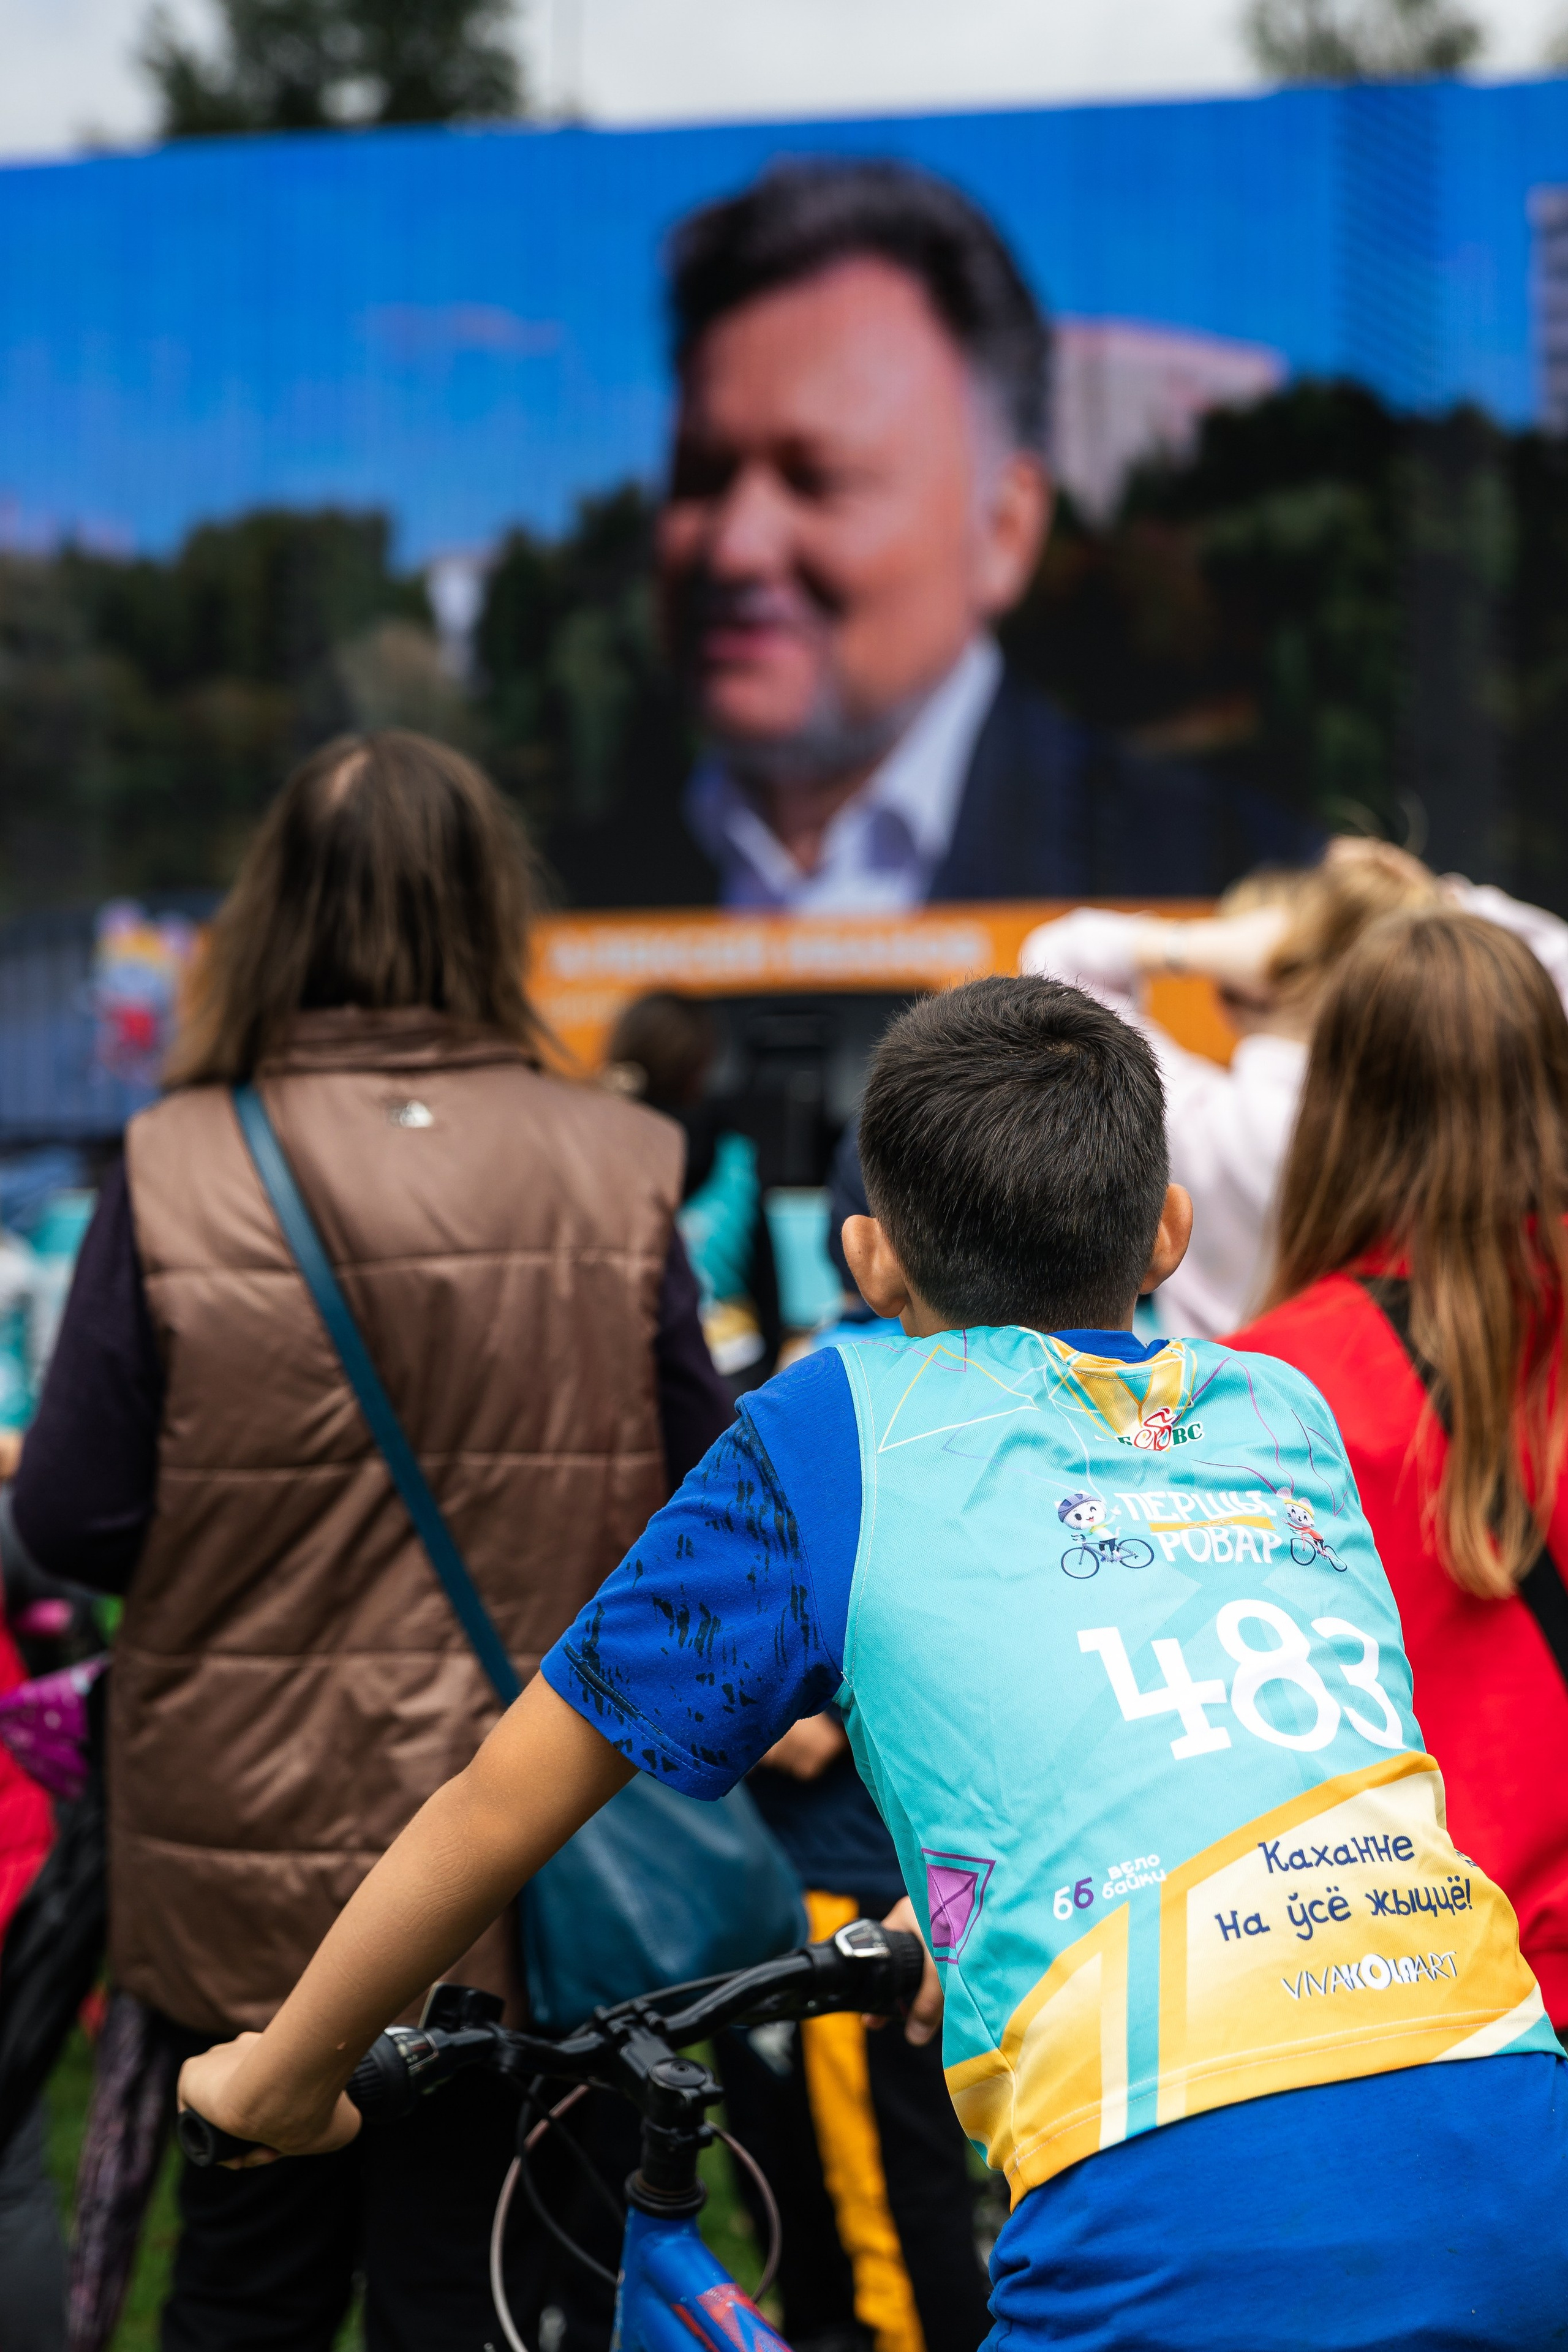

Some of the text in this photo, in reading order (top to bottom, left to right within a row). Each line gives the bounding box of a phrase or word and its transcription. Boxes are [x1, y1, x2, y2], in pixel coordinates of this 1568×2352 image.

[1114, 1490, 1278, 1521] ПЕРШЫ
[1185, 1518, 1234, 1529] 2026
[1150, 1524, 1283, 1564] РОВАР
[1077, 1599, 1408, 1760] 483
[1257, 1834, 1415, 1874] Каханне
[1214, 1875, 1473, 1942] На ўсё жыццё!
